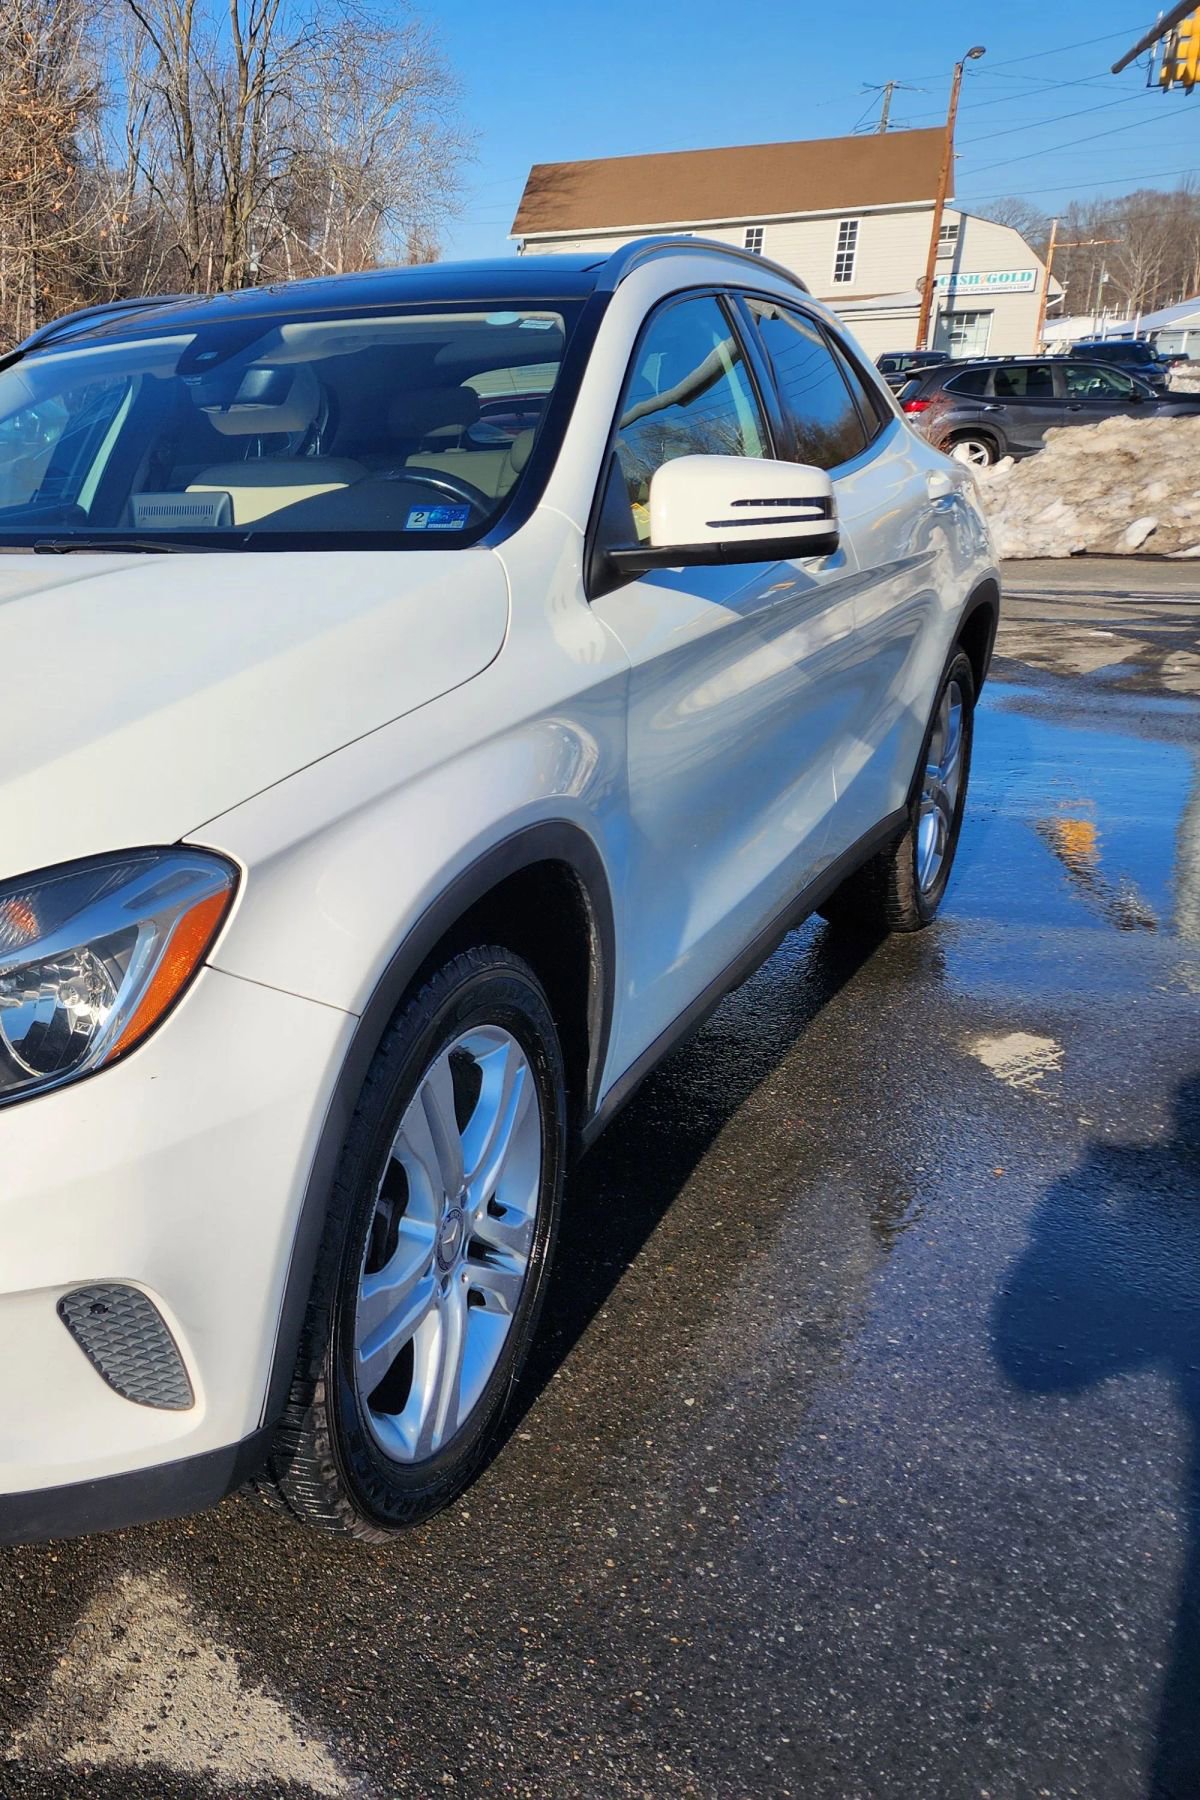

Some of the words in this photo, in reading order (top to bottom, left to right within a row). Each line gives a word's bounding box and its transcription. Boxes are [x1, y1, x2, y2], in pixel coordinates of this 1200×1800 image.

[940, 275, 979, 286] CASH
[987, 272, 1032, 283] GOLD
[414, 512, 425, 523] 2
